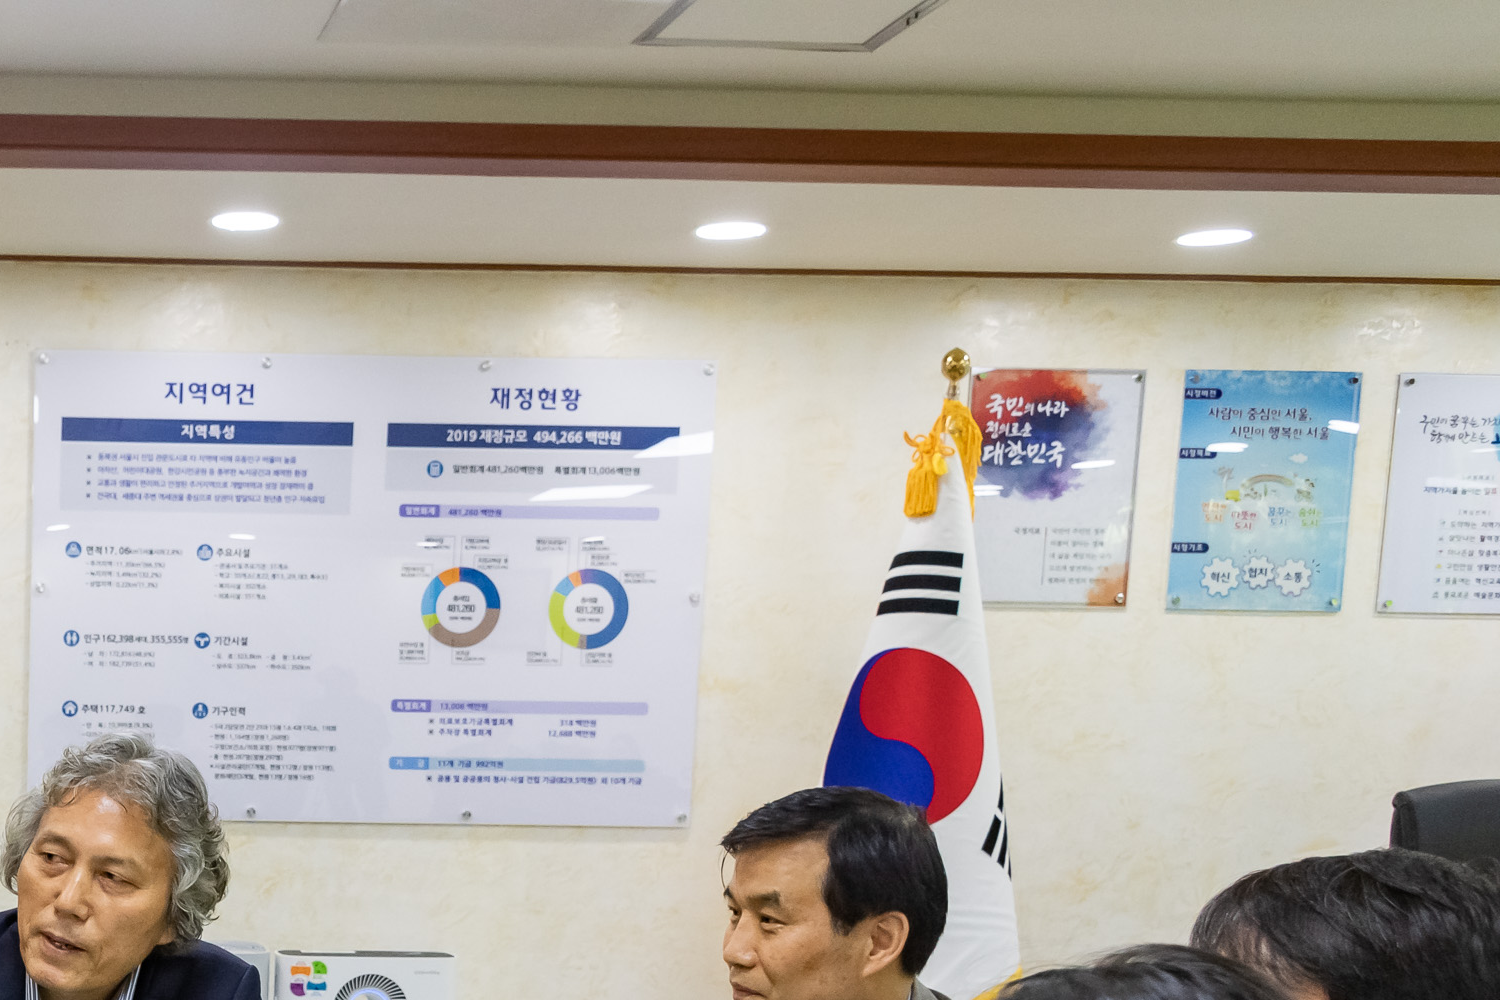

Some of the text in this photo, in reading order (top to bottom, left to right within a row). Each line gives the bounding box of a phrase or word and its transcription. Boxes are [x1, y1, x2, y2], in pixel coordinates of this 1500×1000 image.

[164, 381, 255, 405] 지역여건
[489, 387, 582, 411] 재정현황
[985, 393, 1069, 419] 국민의 나라
[1208, 407, 1243, 420] 사람이
[1247, 407, 1281, 421] 중심인
[181, 424, 236, 440] 지역특성
[446, 430, 622, 445] 2019 재정규모 494,266 백만원
[985, 421, 1032, 439] 정의로운
[1230, 425, 1329, 440] 시민이 행복한 서울
[982, 440, 1066, 468] 대한민국
[216, 548, 250, 558] 주요시설
[1211, 571, 1231, 583] 혁신
[1248, 567, 1268, 579] 협치
[1283, 572, 1303, 583] 소통
[214, 636, 248, 647] 기간시설
[211, 707, 246, 717] 기구인력
